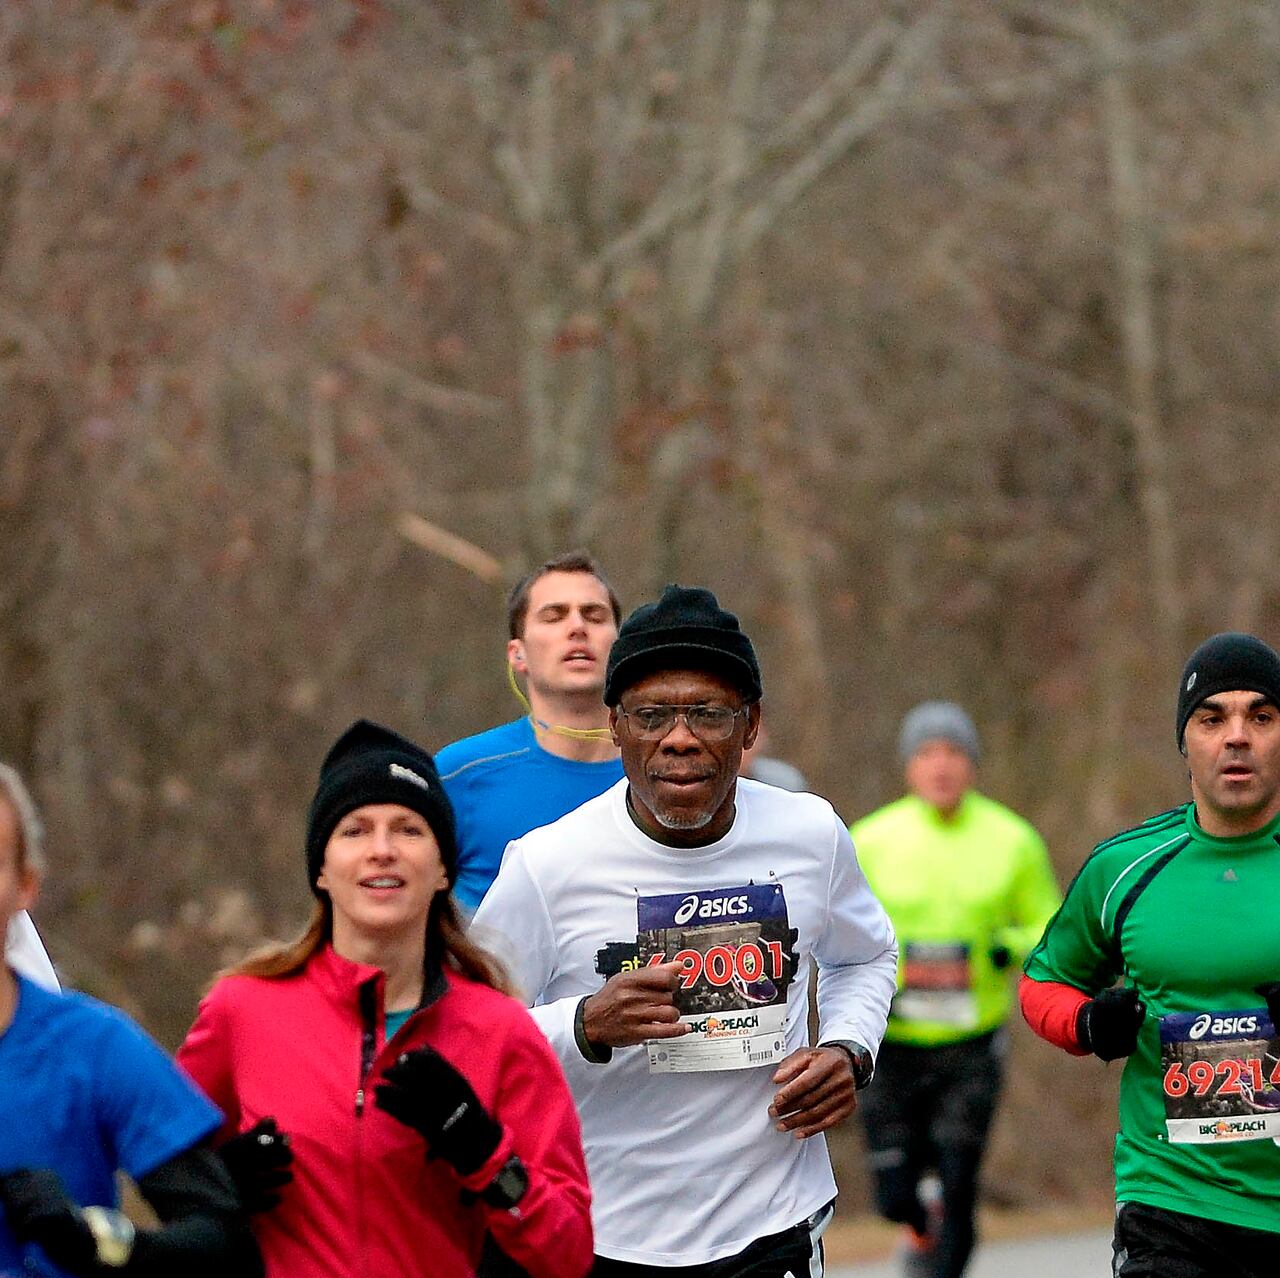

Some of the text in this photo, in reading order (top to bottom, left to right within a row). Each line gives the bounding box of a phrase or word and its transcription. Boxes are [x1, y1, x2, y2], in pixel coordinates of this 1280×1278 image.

[698, 895, 748, 918] asics
[722, 1014, 759, 1030] PEACH
[1211, 1015, 1257, 1035] asics
